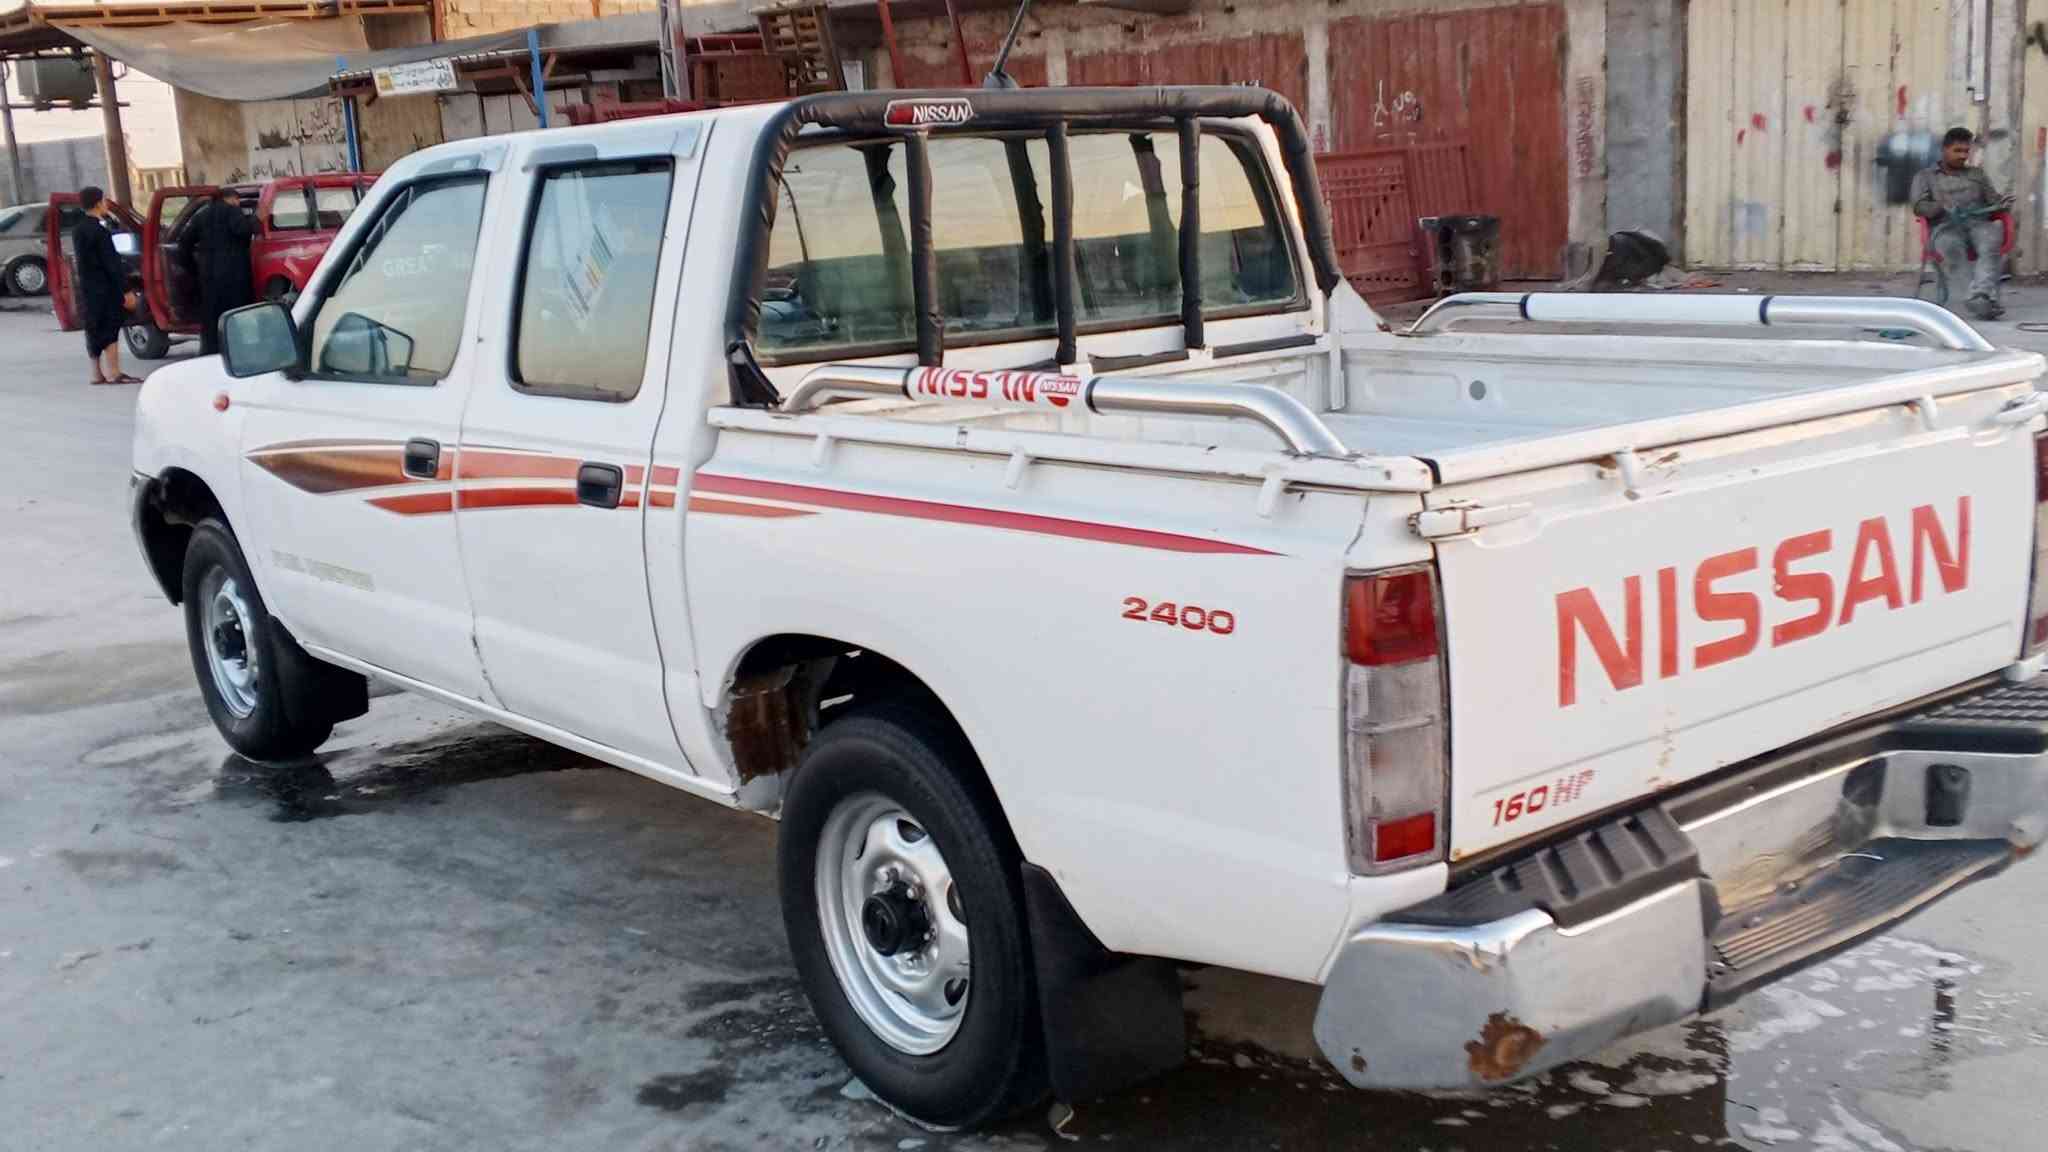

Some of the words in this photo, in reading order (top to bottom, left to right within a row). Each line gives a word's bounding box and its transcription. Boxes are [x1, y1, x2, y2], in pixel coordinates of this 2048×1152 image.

[912, 104, 970, 123] NISSAN
[1121, 596, 1234, 635] 2400
[1555, 495, 1972, 708] NISSAN
[1493, 785, 1548, 826] 160
[1552, 769, 1595, 807] HP
